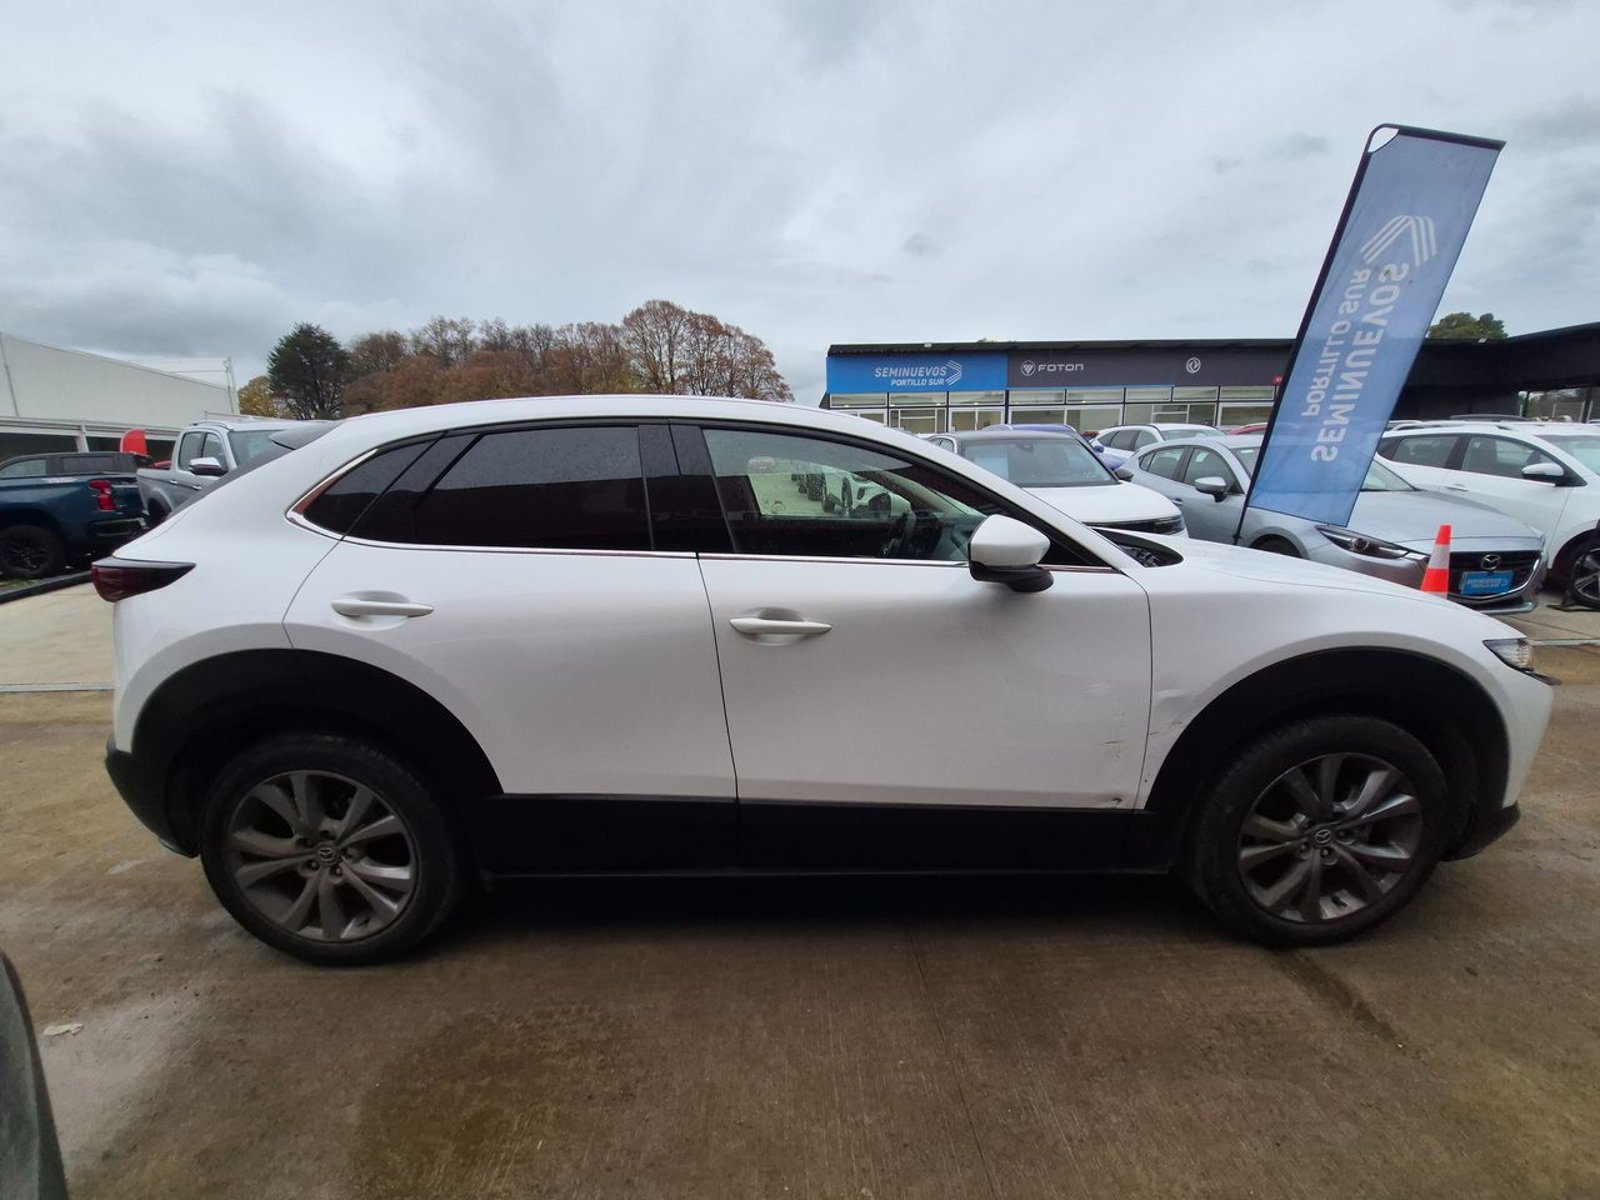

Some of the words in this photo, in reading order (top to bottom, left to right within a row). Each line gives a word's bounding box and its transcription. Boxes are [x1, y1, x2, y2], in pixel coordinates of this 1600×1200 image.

[874, 366, 947, 378] SEMINUEVOS
[1038, 363, 1084, 372] FOTON
[890, 378, 927, 387] PORTILLO
[928, 378, 945, 386] SUR
